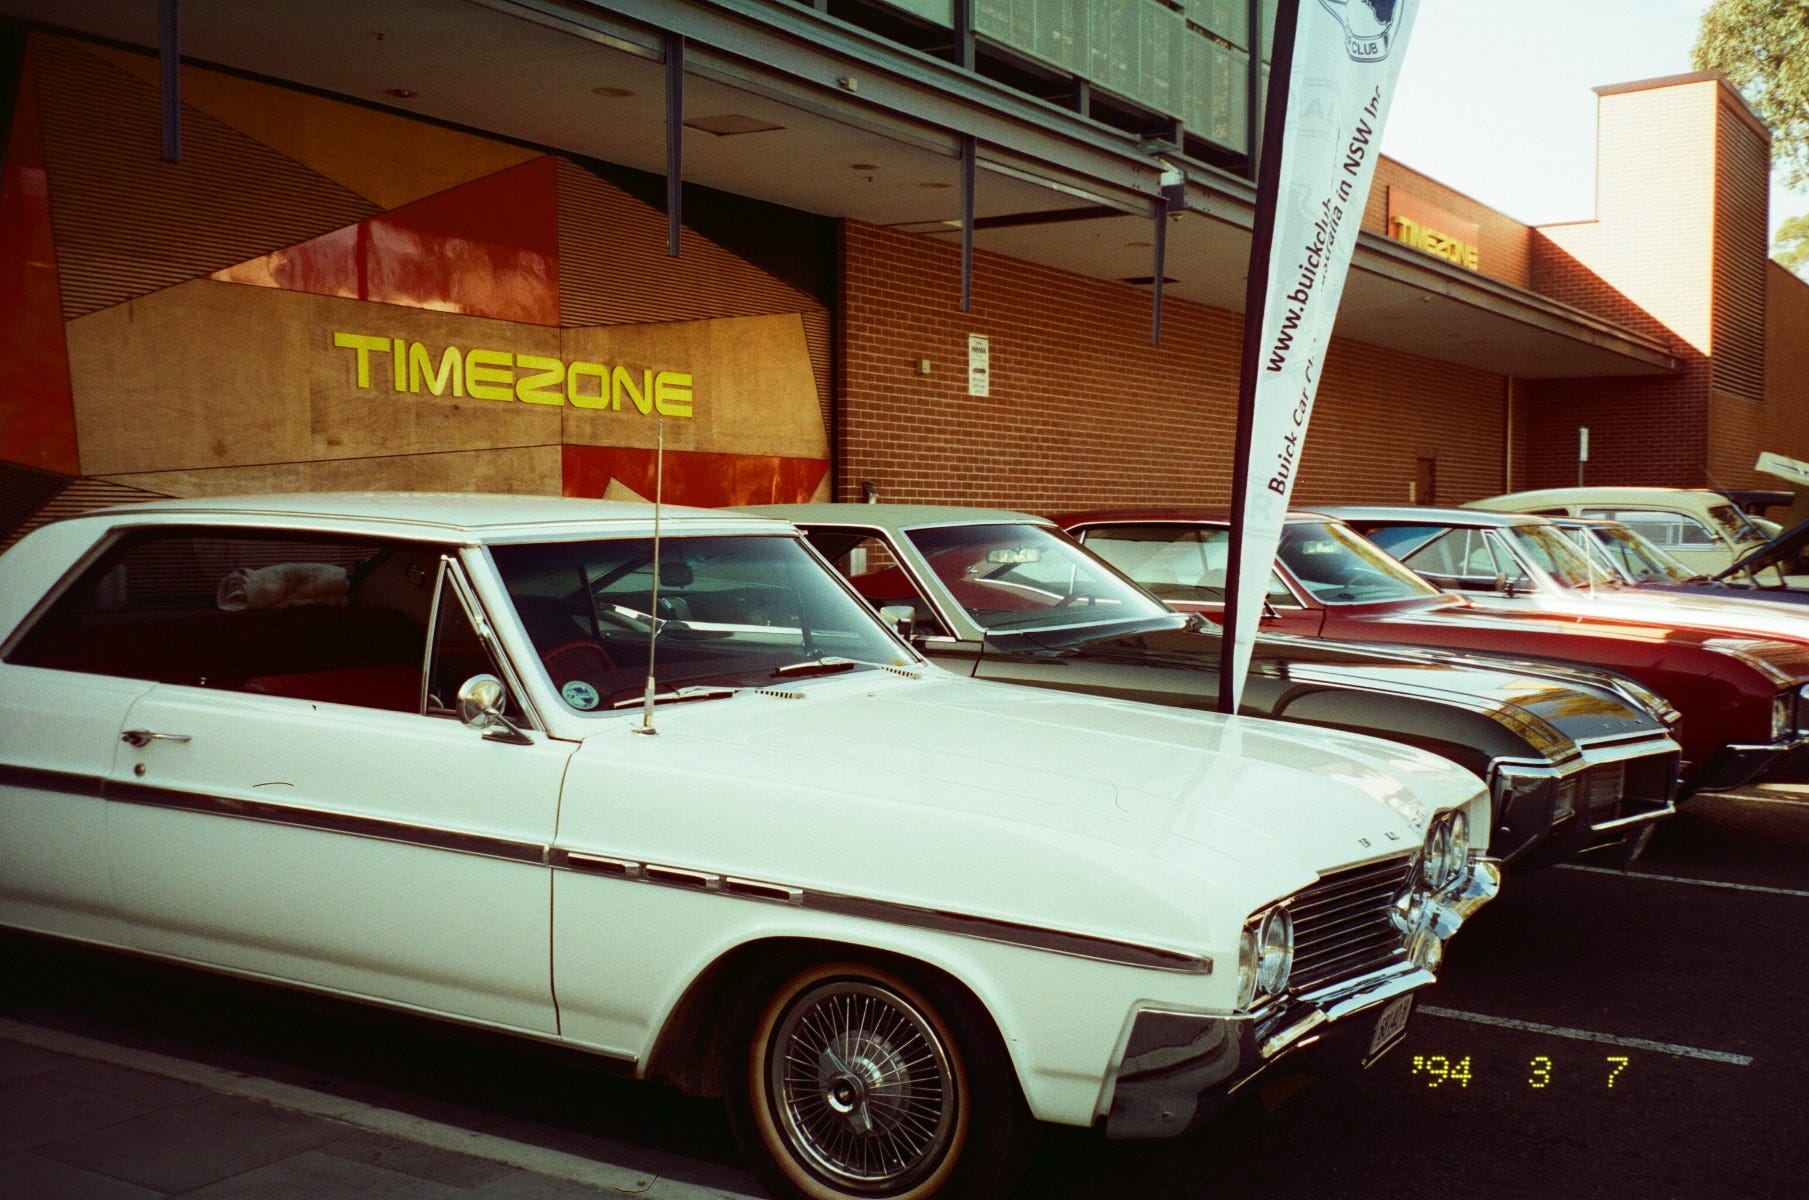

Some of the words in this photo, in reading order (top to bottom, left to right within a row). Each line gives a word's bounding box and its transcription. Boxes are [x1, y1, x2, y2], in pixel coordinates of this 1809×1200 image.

[1351, 41, 1379, 55] CLUB
[1343, 118, 1373, 177] NSW
[1336, 180, 1353, 203] in
[1394, 214, 1479, 272] TIMEZONE
[334, 332, 693, 418] TIMEZONE
[1268, 431, 1298, 496] Buick
